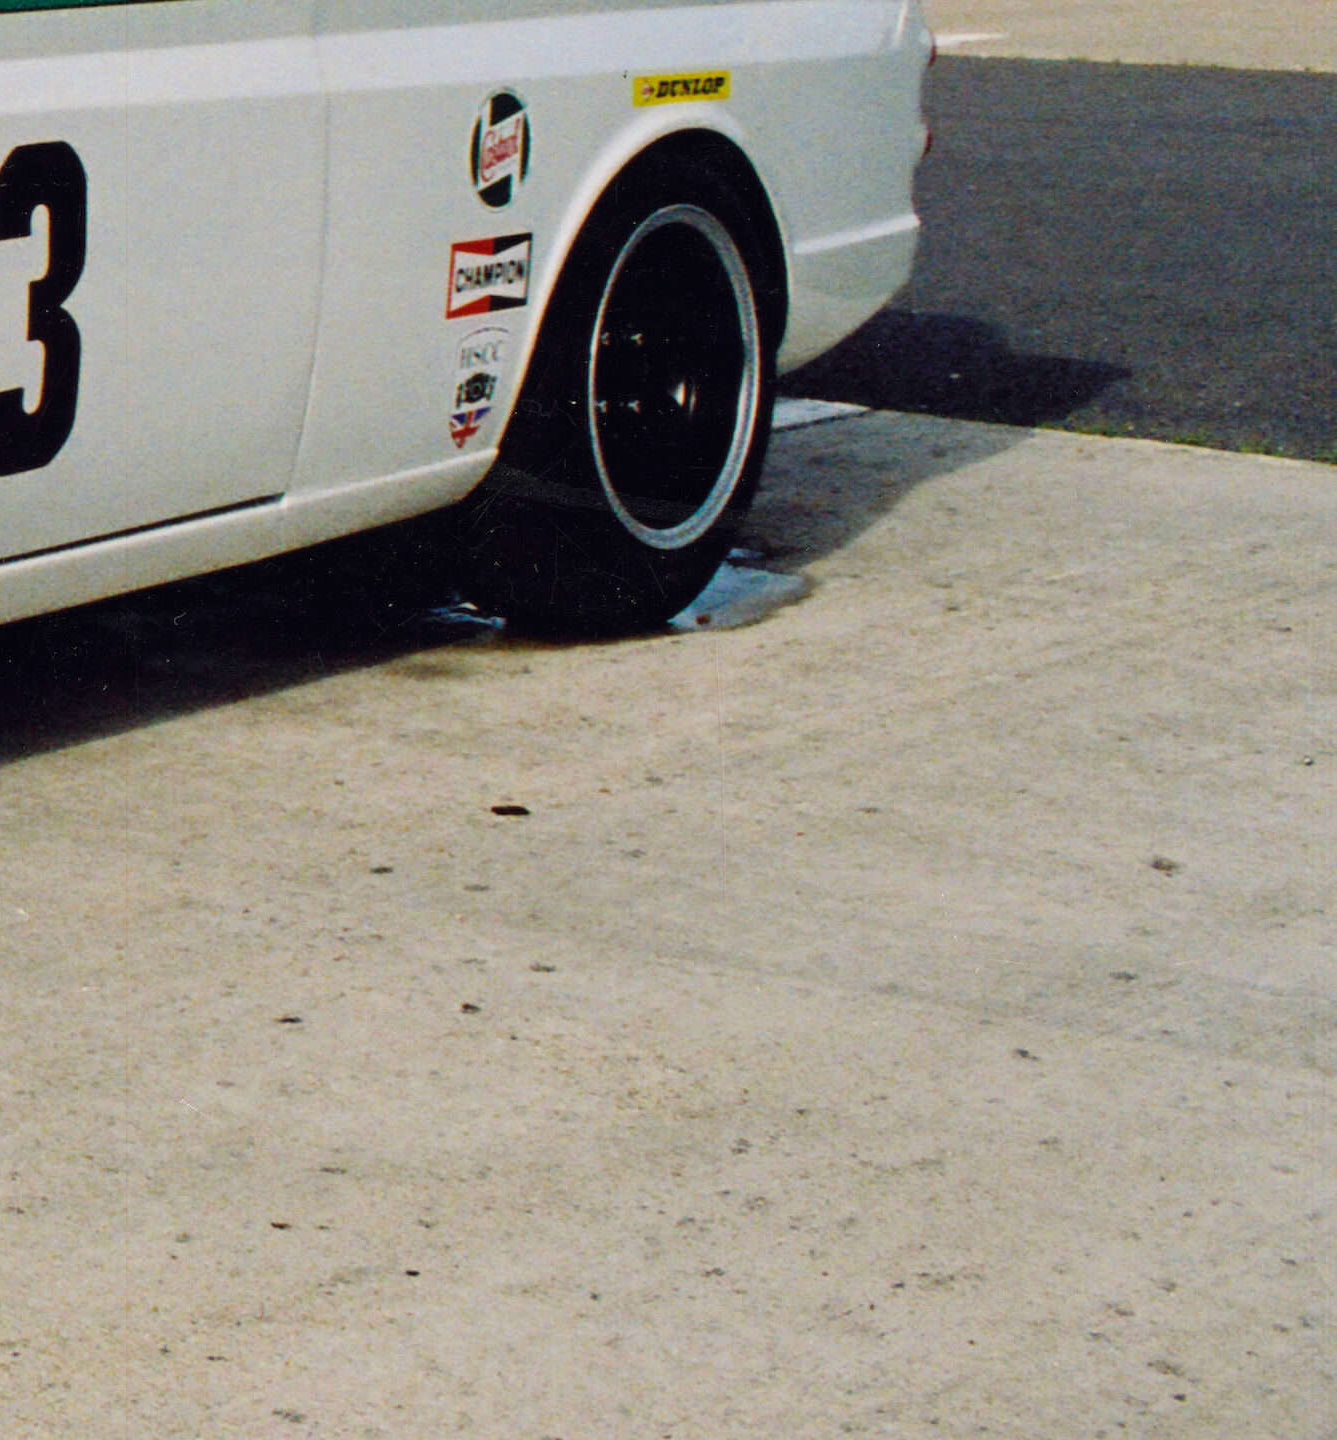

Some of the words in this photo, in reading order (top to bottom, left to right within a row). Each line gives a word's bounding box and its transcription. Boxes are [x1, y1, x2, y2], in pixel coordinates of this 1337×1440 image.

[655, 76, 725, 98] DUNLOP
[480, 118, 521, 182] Castrol
[456, 259, 525, 293] CHAMPION
